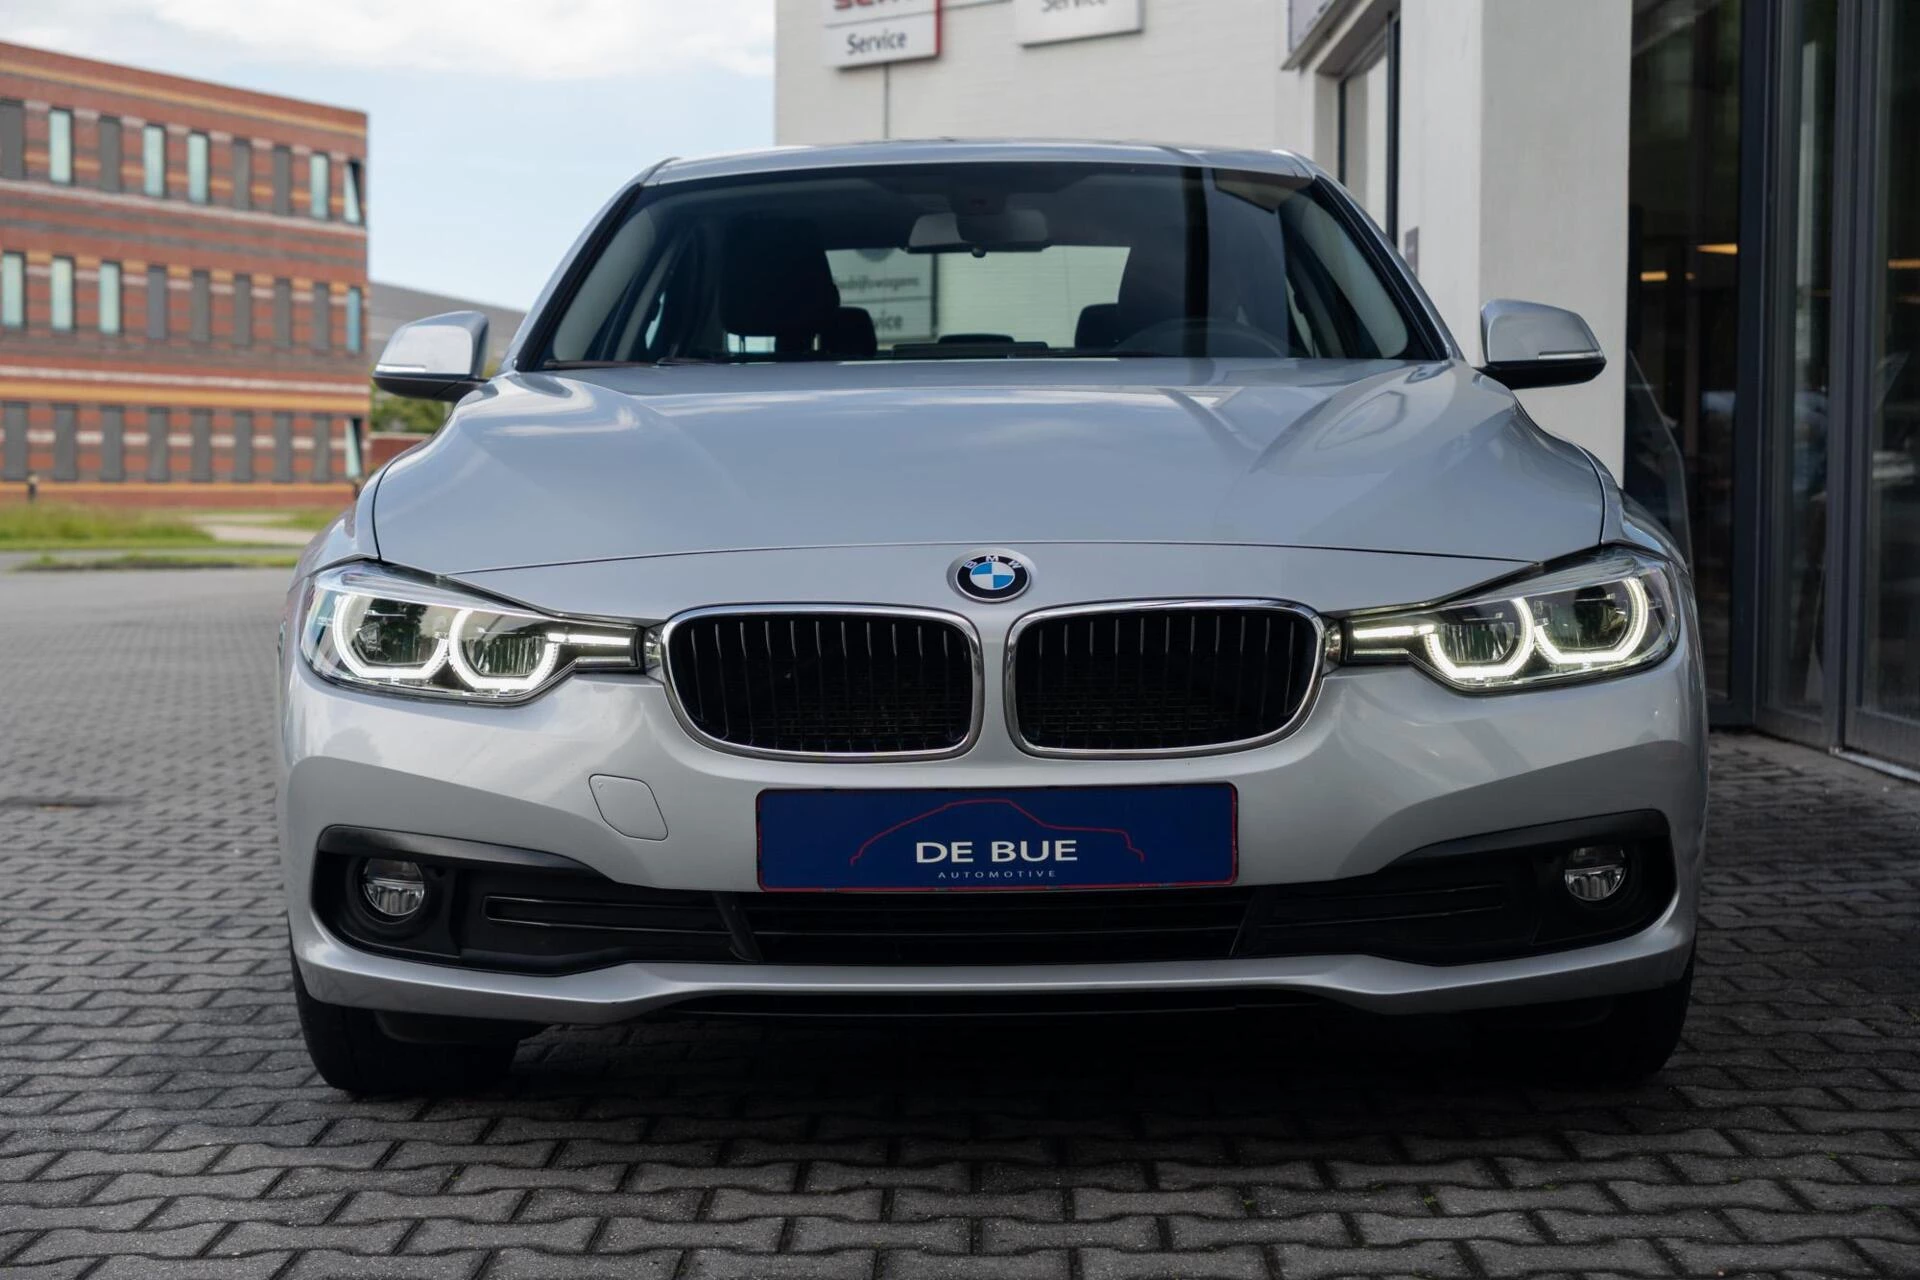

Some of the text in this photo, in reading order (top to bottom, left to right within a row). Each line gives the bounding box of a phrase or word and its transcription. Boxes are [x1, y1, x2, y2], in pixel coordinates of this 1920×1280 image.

[846, 28, 907, 56] Service
[964, 554, 1022, 569] BMW
[915, 839, 1079, 864] DE BUE
[937, 869, 1057, 879] AUTOMOTIVE
